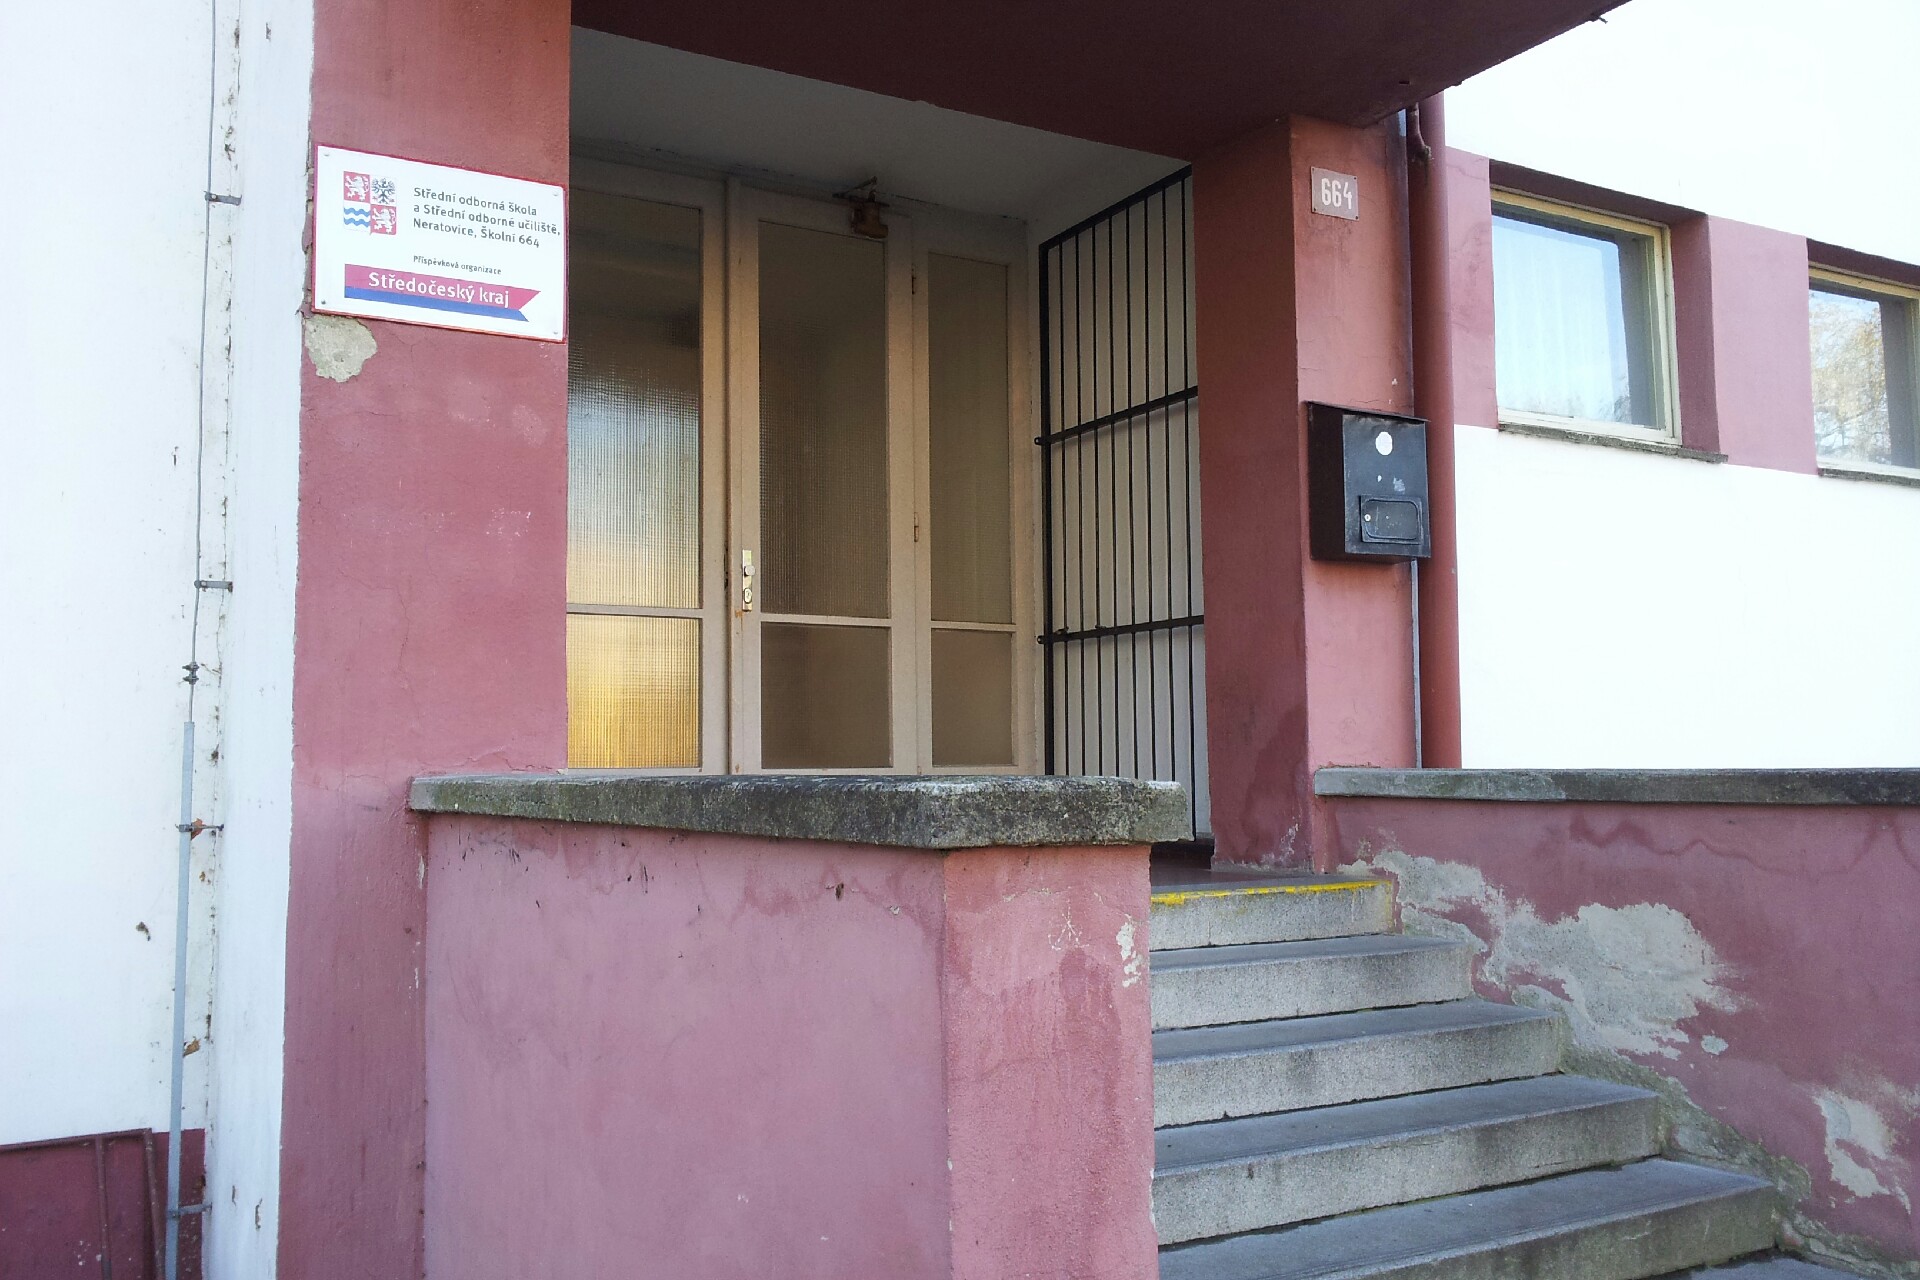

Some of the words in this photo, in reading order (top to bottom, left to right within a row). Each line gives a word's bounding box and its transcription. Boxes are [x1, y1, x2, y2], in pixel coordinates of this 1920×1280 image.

[413, 187, 457, 203] Střední
[458, 195, 505, 211] odborná
[508, 201, 537, 216] škola
[1321, 177, 1352, 210] 664
[413, 204, 420, 213] a
[423, 204, 466, 220] Střední
[468, 211, 515, 228] odborné
[518, 219, 561, 236] učiliště,
[413, 217, 477, 239] Neratovice,
[480, 225, 516, 243] Školní
[518, 234, 540, 249] 664
[413, 255, 459, 270] Příspěvková
[460, 262, 502, 275] organizace
[368, 271, 475, 304] Středočeský
[479, 285, 510, 308] kraj
